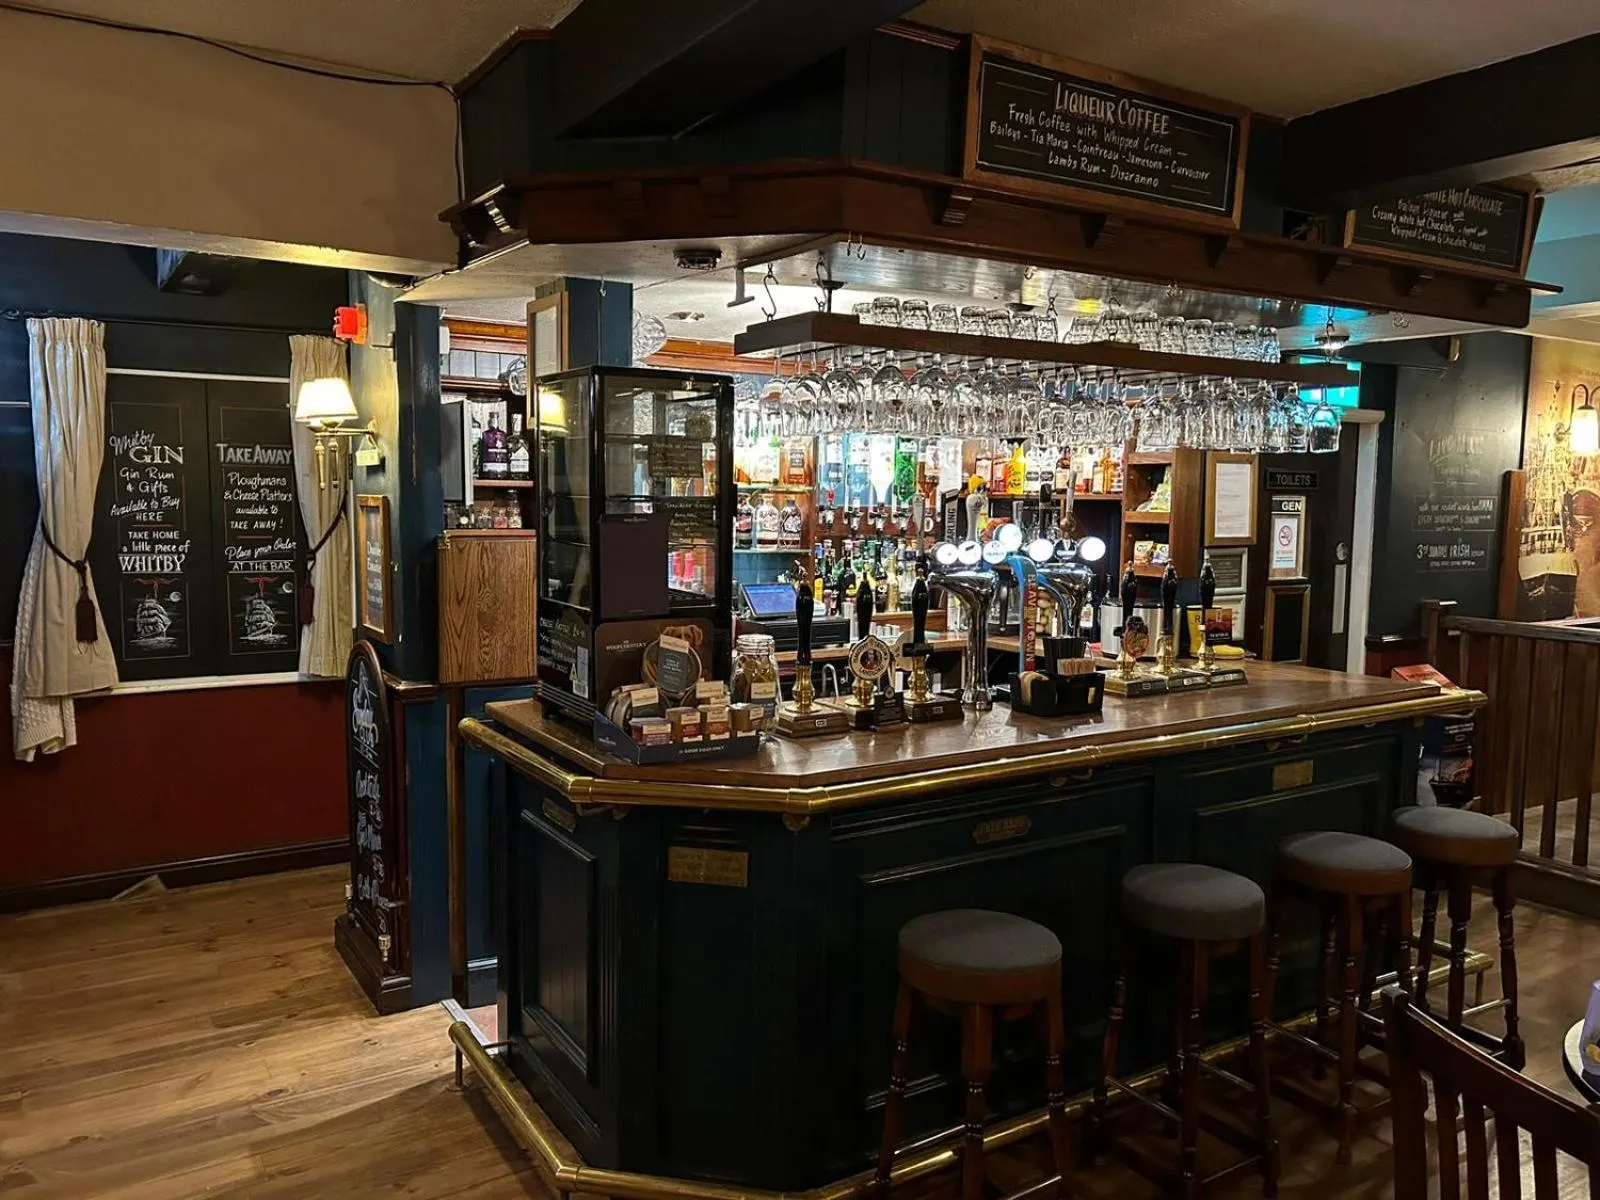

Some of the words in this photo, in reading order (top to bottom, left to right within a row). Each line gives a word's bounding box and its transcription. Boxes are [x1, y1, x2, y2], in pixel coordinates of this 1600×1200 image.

[1056, 81, 1115, 124] LIQUEUR
[1118, 98, 1170, 135] COFFEE
[1008, 103, 1035, 125] Fresh
[1038, 110, 1071, 132] Coffee
[1076, 122, 1098, 138] with
[1103, 126, 1139, 151] Whipped
[1143, 137, 1172, 156] Cream
[989, 120, 1021, 142] Baileys
[1031, 129, 1044, 144] Tia
[1046, 132, 1069, 149] Maria
[1077, 138, 1119, 161] Cointreau
[1048, 151, 1077, 170] Lambs
[1080, 157, 1101, 173] Rum
[109, 429, 156, 456] Whitby
[129, 445, 184, 465] GIN
[215, 443, 253, 464] TAKE
[252, 444, 293, 465] AWAY
[119, 466, 140, 480] Gin
[145, 466, 175, 480] Rum
[227, 472, 287, 491] Ploughmans
[1275, 473, 1311, 486] TOILETS
[138, 480, 169, 499] Gifts
[223, 490, 232, 501] &
[231, 488, 259, 501] Cheese
[260, 487, 292, 502] Platters
[110, 500, 149, 517] Available
[150, 498, 159, 510] to
[160, 496, 180, 511] Buy
[235, 504, 270, 515] available
[270, 504, 279, 515] to
[1281, 501, 1302, 512] GEN
[135, 511, 164, 522] HERE
[229, 520, 249, 530] TAKE
[127, 530, 150, 541] TAKE
[152, 530, 180, 540] HOME
[132, 541, 152, 553] little
[154, 543, 177, 555] piece
[178, 539, 191, 554] of
[224, 545, 251, 561] Place
[253, 544, 272, 559] your
[118, 554, 186, 573] WHITBY
[231, 560, 244, 571] AT
[249, 560, 268, 571] THE
[269, 560, 293, 571] BAR
